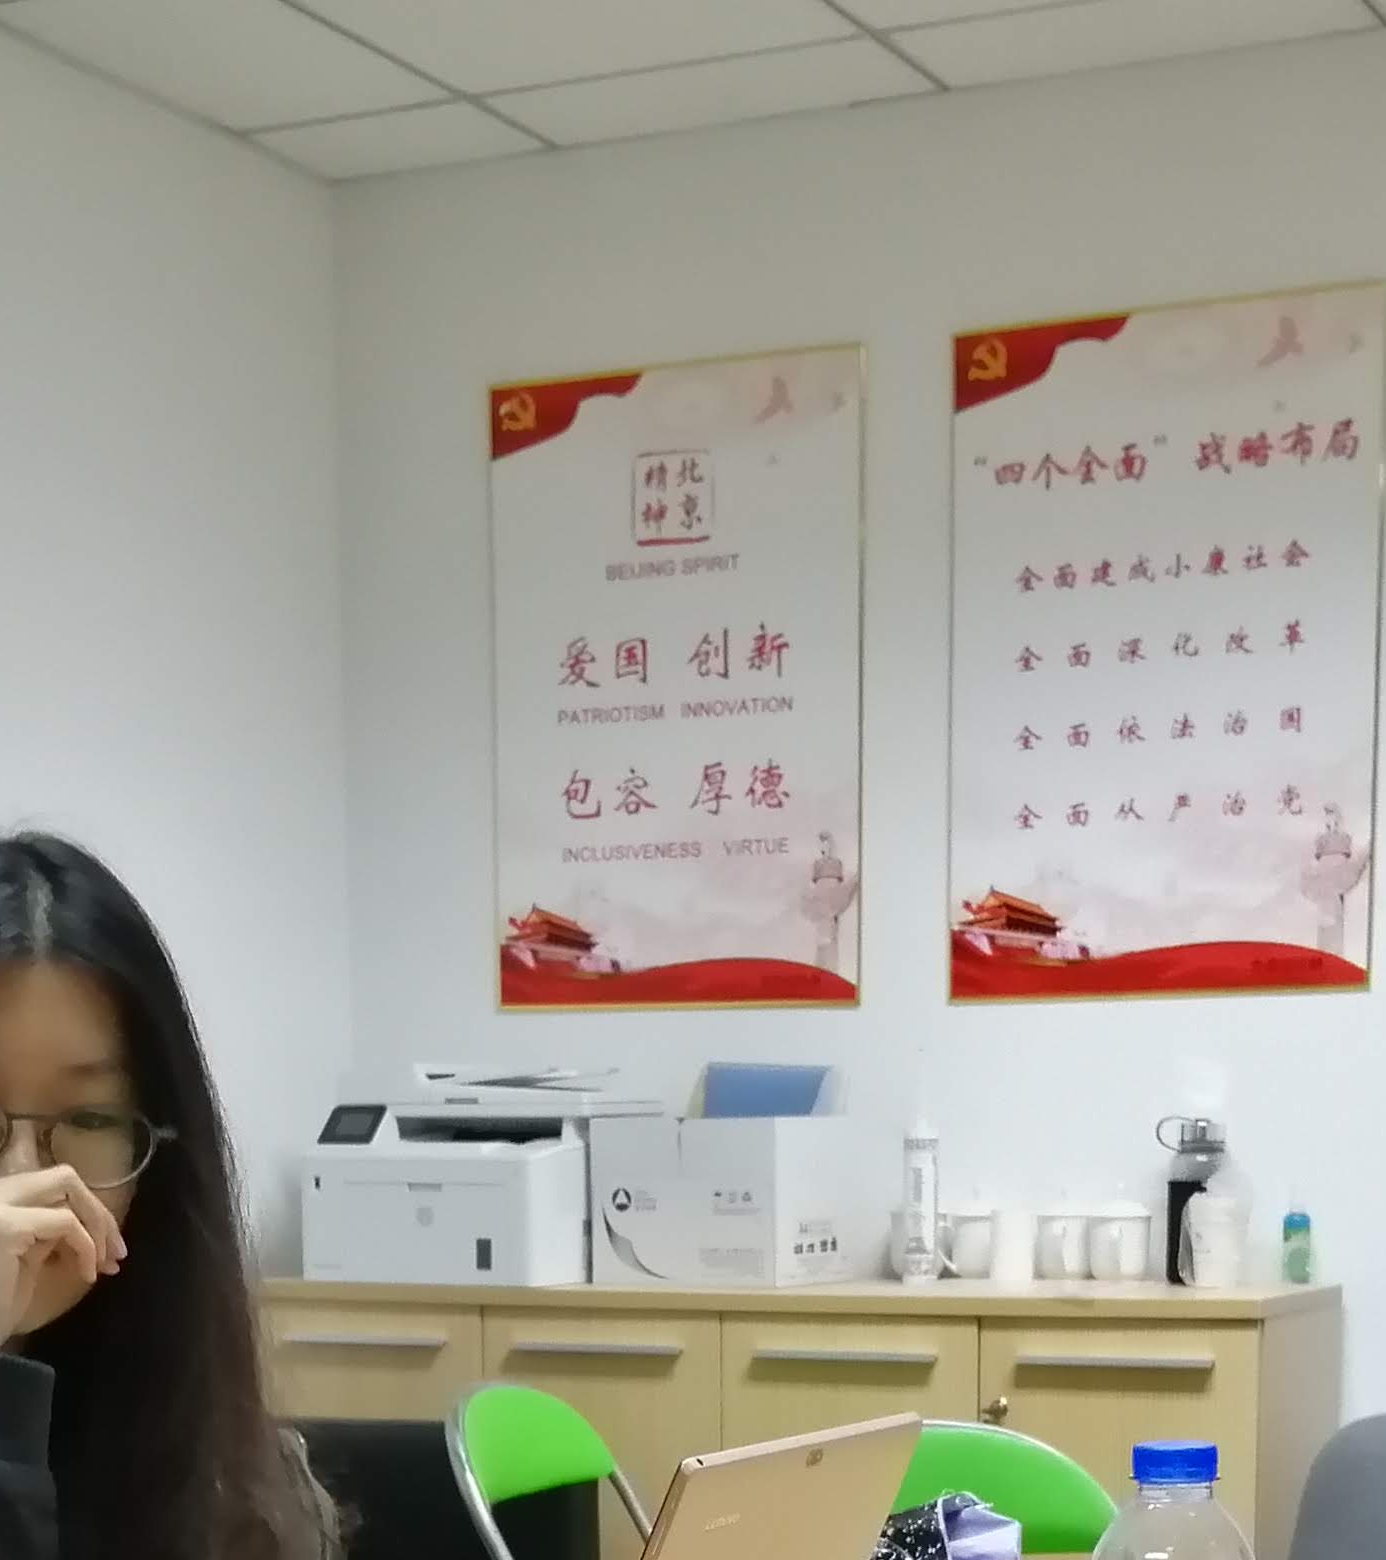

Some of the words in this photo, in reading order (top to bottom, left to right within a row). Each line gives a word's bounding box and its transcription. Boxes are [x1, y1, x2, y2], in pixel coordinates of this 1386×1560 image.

[605, 560, 676, 582] BEIJING
[681, 553, 740, 576] SPIRIT
[1016, 539, 1309, 592] 全面建成小康社会
[558, 636, 648, 688] 爱国
[688, 621, 790, 679] 创新
[1014, 619, 1305, 672] 全面深化改革
[557, 703, 666, 725] PATRIOTISM
[679, 695, 794, 719] INNOVATION
[1013, 705, 1302, 751] 全面依法治国
[562, 768, 659, 820] 包容
[690, 757, 791, 816] 厚德
[1013, 784, 1304, 829] 全面从严治党
[562, 840, 704, 864] INCLUSIVENESS
[722, 836, 791, 857] VIRTUE
